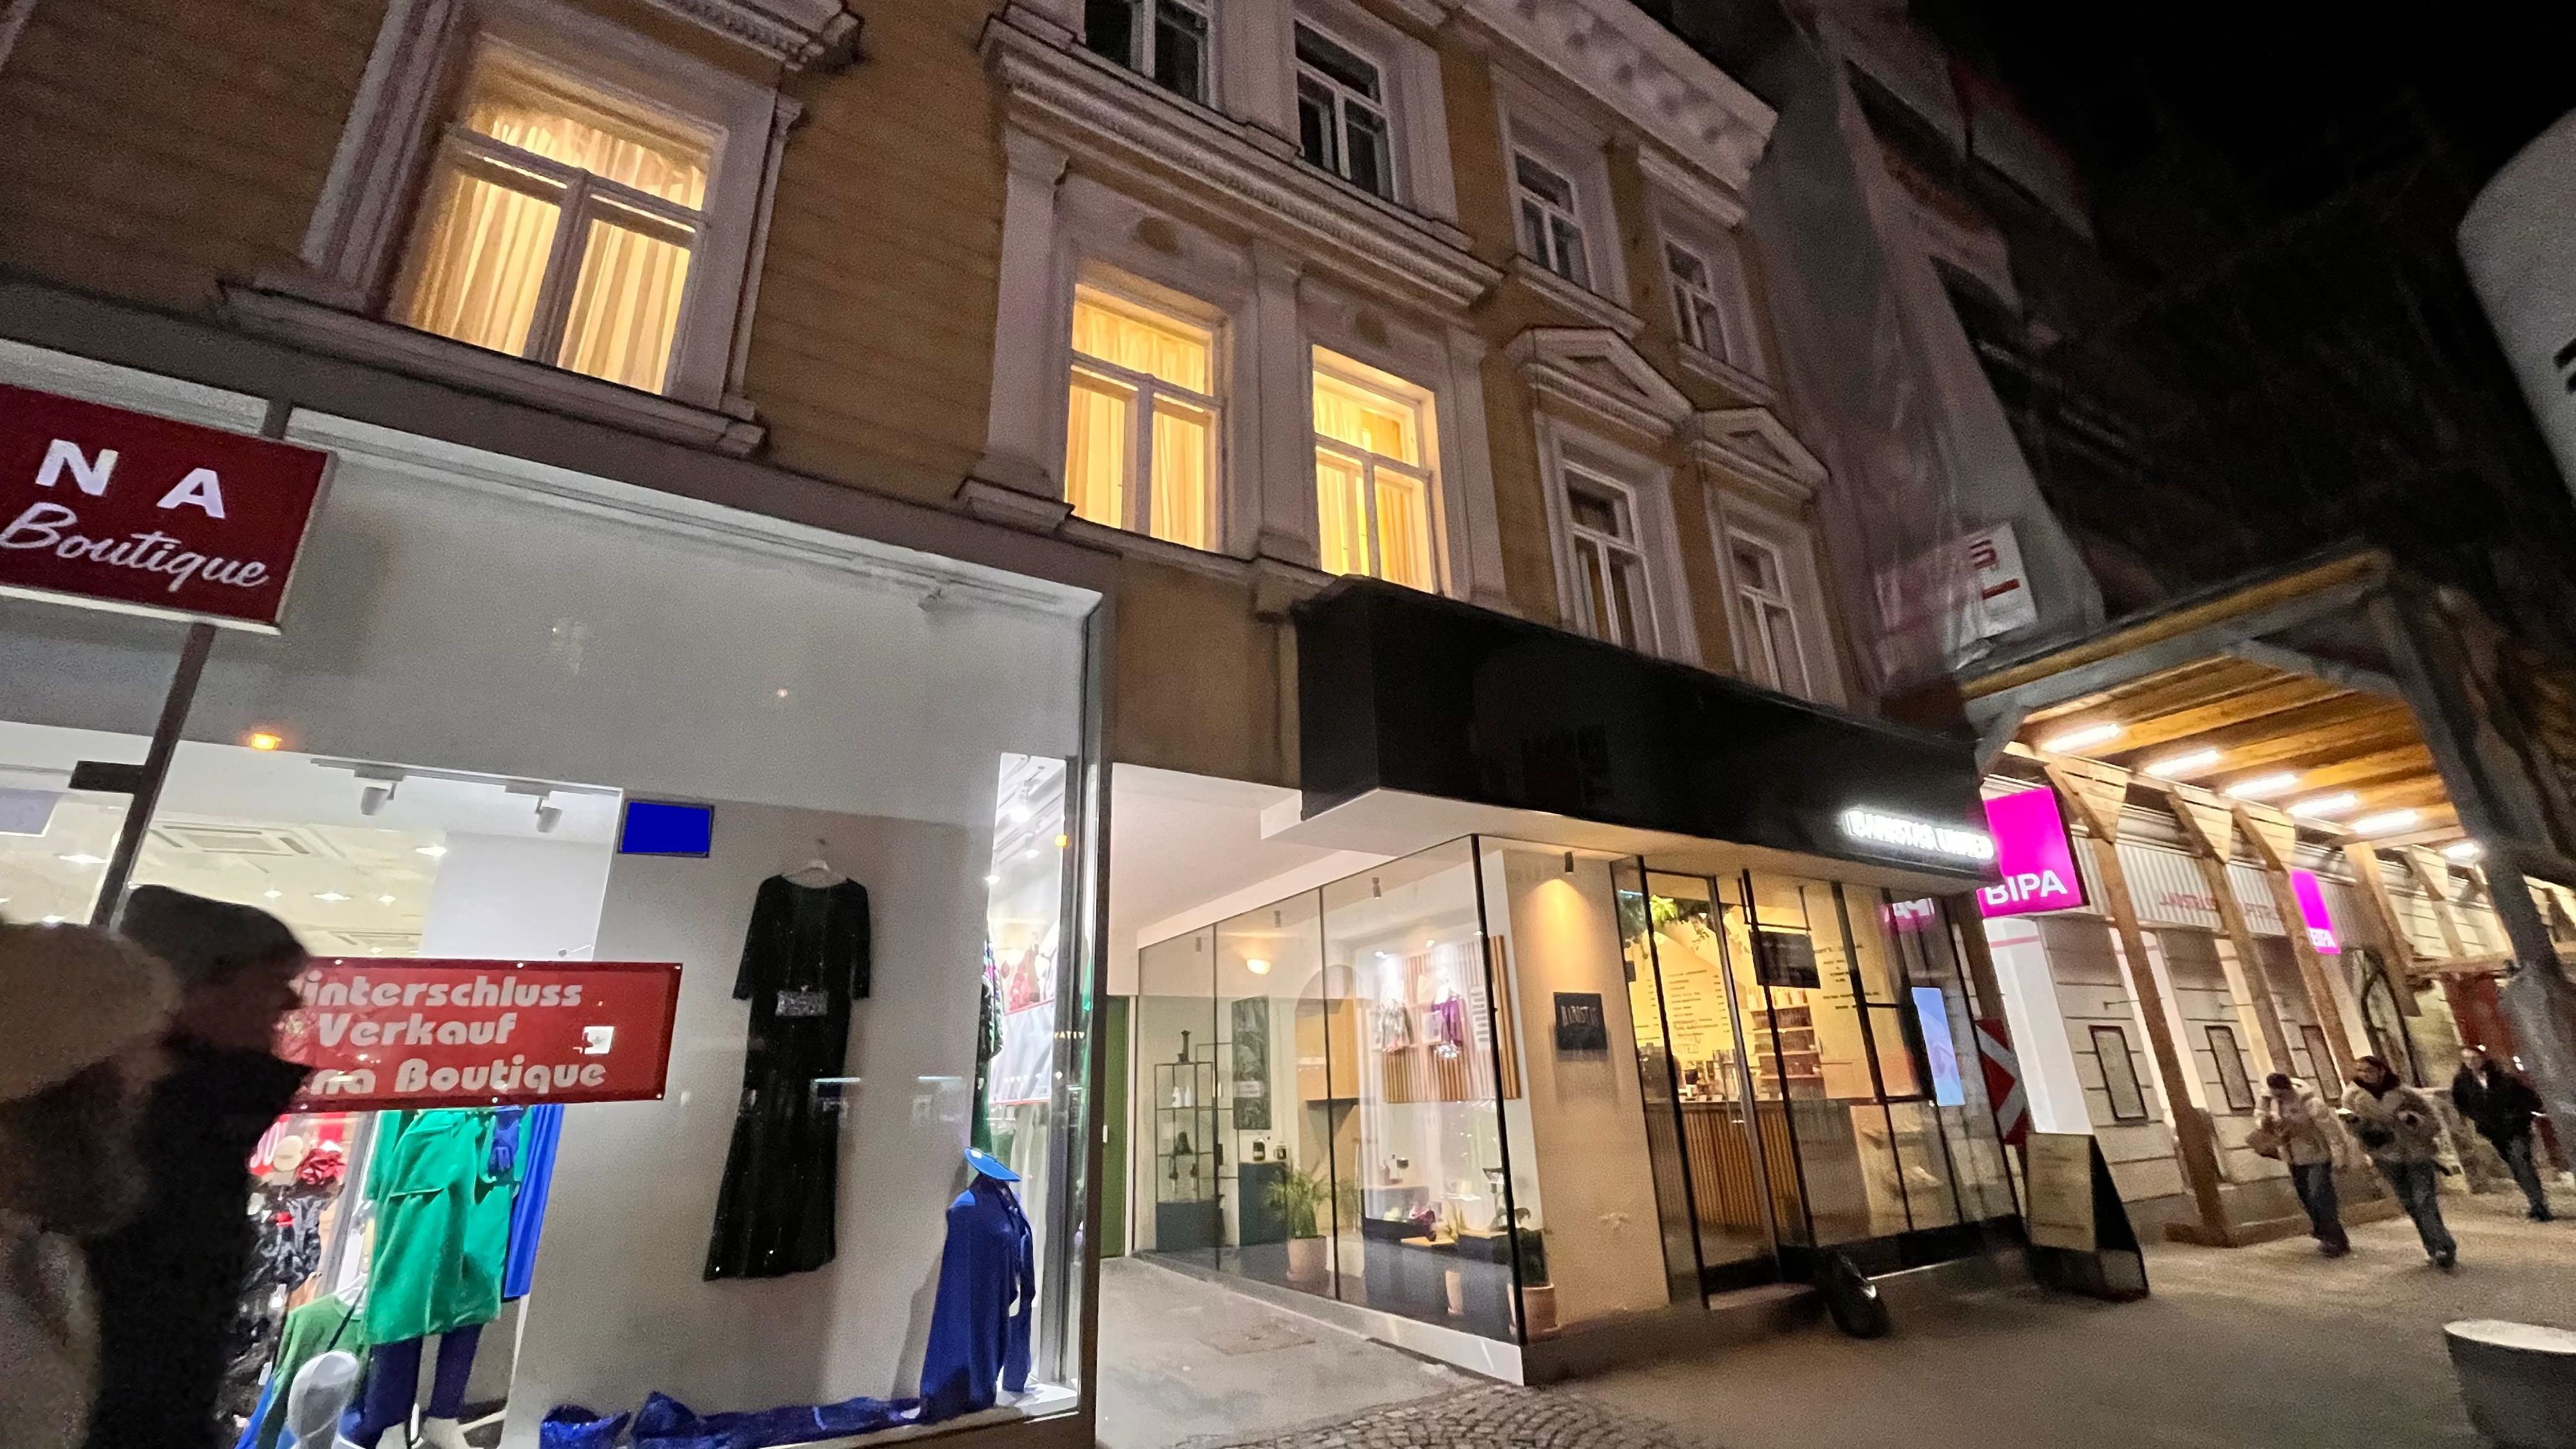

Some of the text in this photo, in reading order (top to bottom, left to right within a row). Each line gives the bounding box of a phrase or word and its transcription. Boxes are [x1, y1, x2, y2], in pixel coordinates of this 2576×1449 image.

[0, 502, 269, 592] Boutique
[1984, 869, 2069, 905] BIPA
[290, 969, 583, 1007] interschluss
[319, 1012, 518, 1048] Verkauf
[309, 1054, 606, 1095] na Boutique
